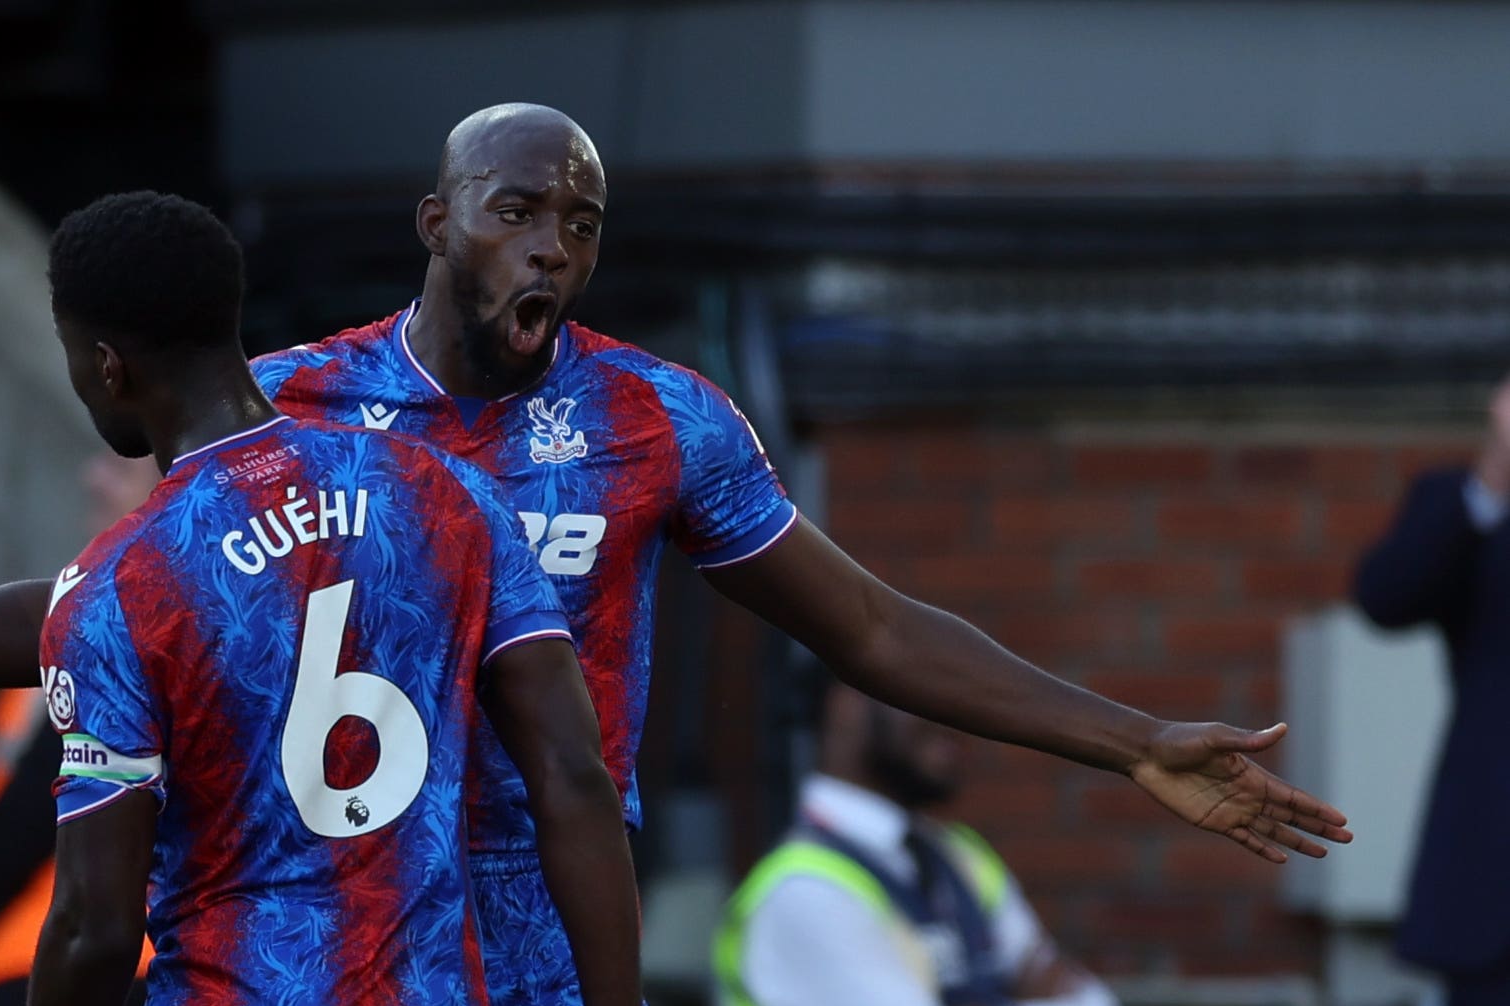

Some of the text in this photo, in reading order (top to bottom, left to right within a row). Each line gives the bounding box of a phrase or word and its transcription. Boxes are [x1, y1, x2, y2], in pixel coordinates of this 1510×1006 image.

[214, 443, 301, 485] SELHURST
[246, 463, 286, 482] PARK
[221, 486, 368, 575] GUÉHI
[281, 579, 429, 838] 6
[62, 742, 108, 765] tain
